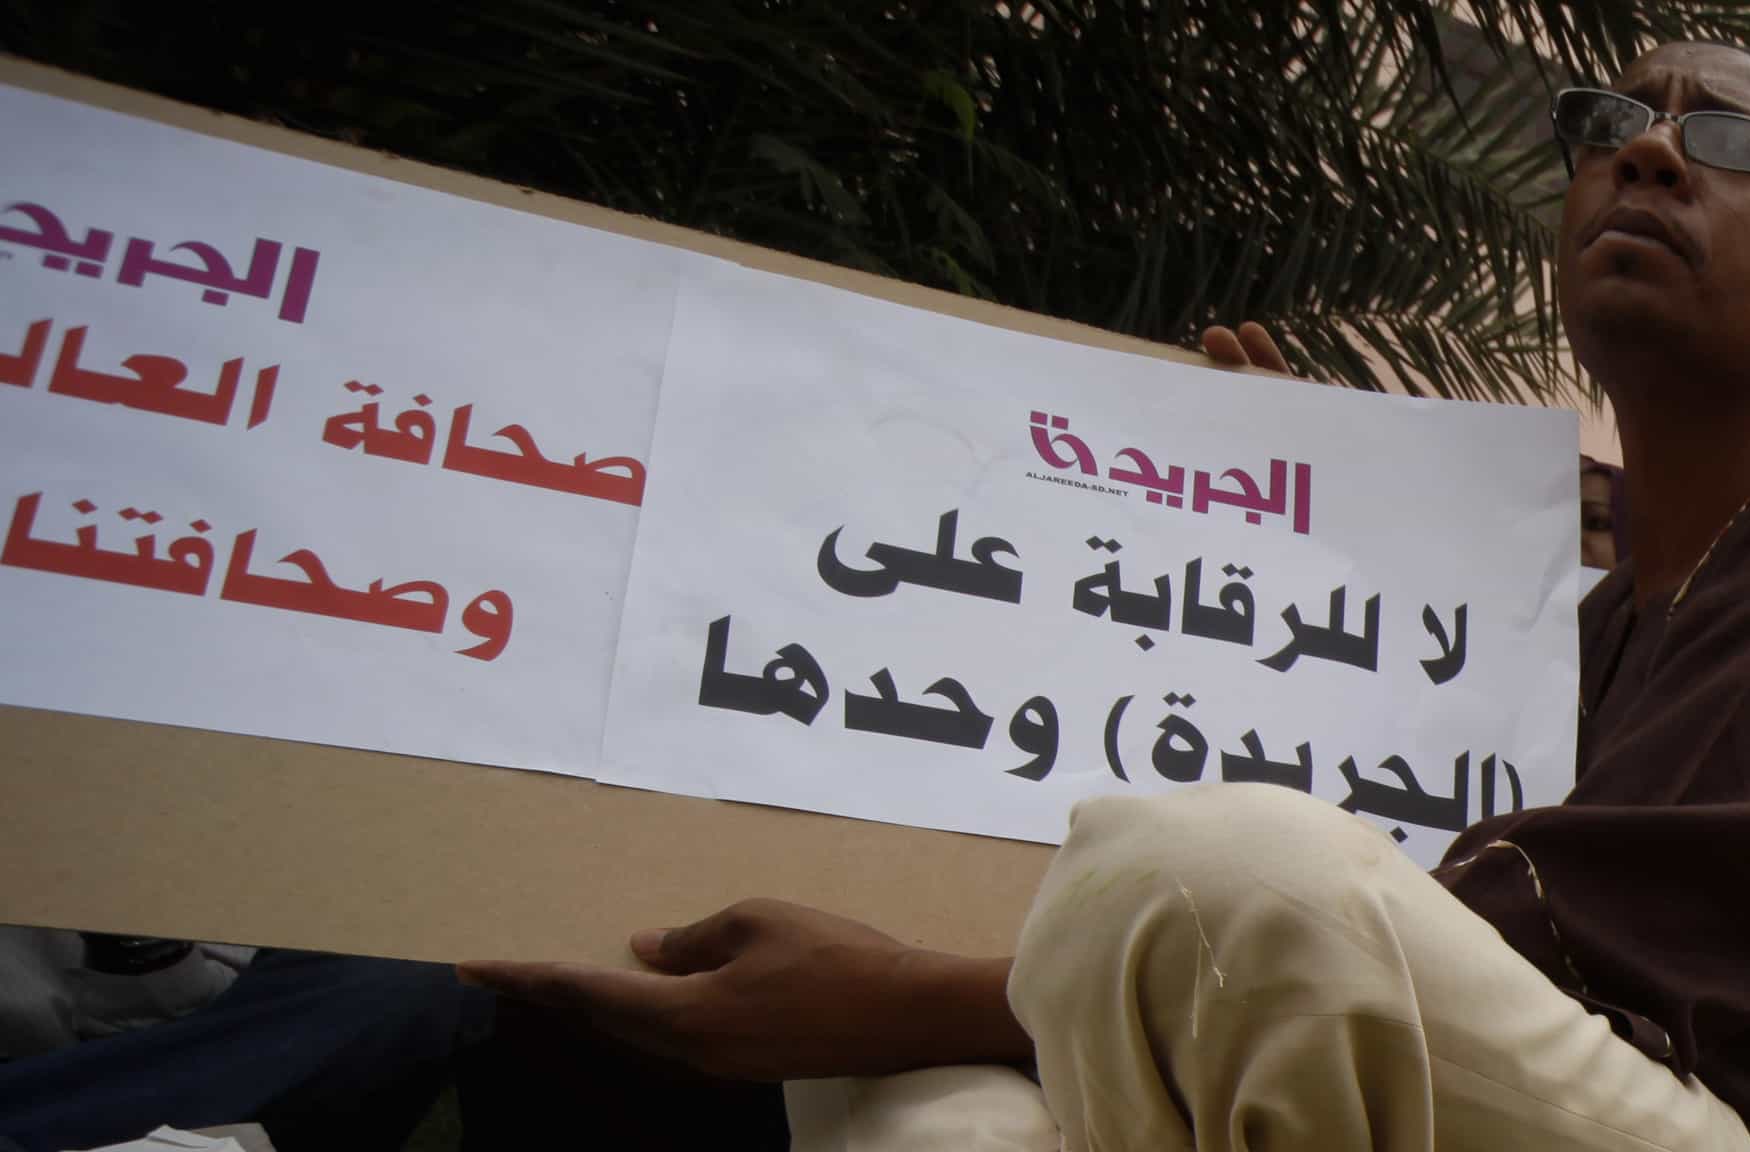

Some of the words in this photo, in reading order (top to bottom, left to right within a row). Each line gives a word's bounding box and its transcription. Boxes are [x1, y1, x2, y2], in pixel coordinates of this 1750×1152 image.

[0, 201, 320, 324] الجريد
[0, 317, 281, 431] العال
[323, 380, 648, 508] صحافة
[1029, 410, 1312, 537] الجريدة
[1, 490, 514, 662] وصحافتنا
[817, 508, 1024, 606] على
[1073, 535, 1381, 673] للرقابة
[699, 614, 1060, 783] وحدها
[1420, 603, 1468, 687] لا
